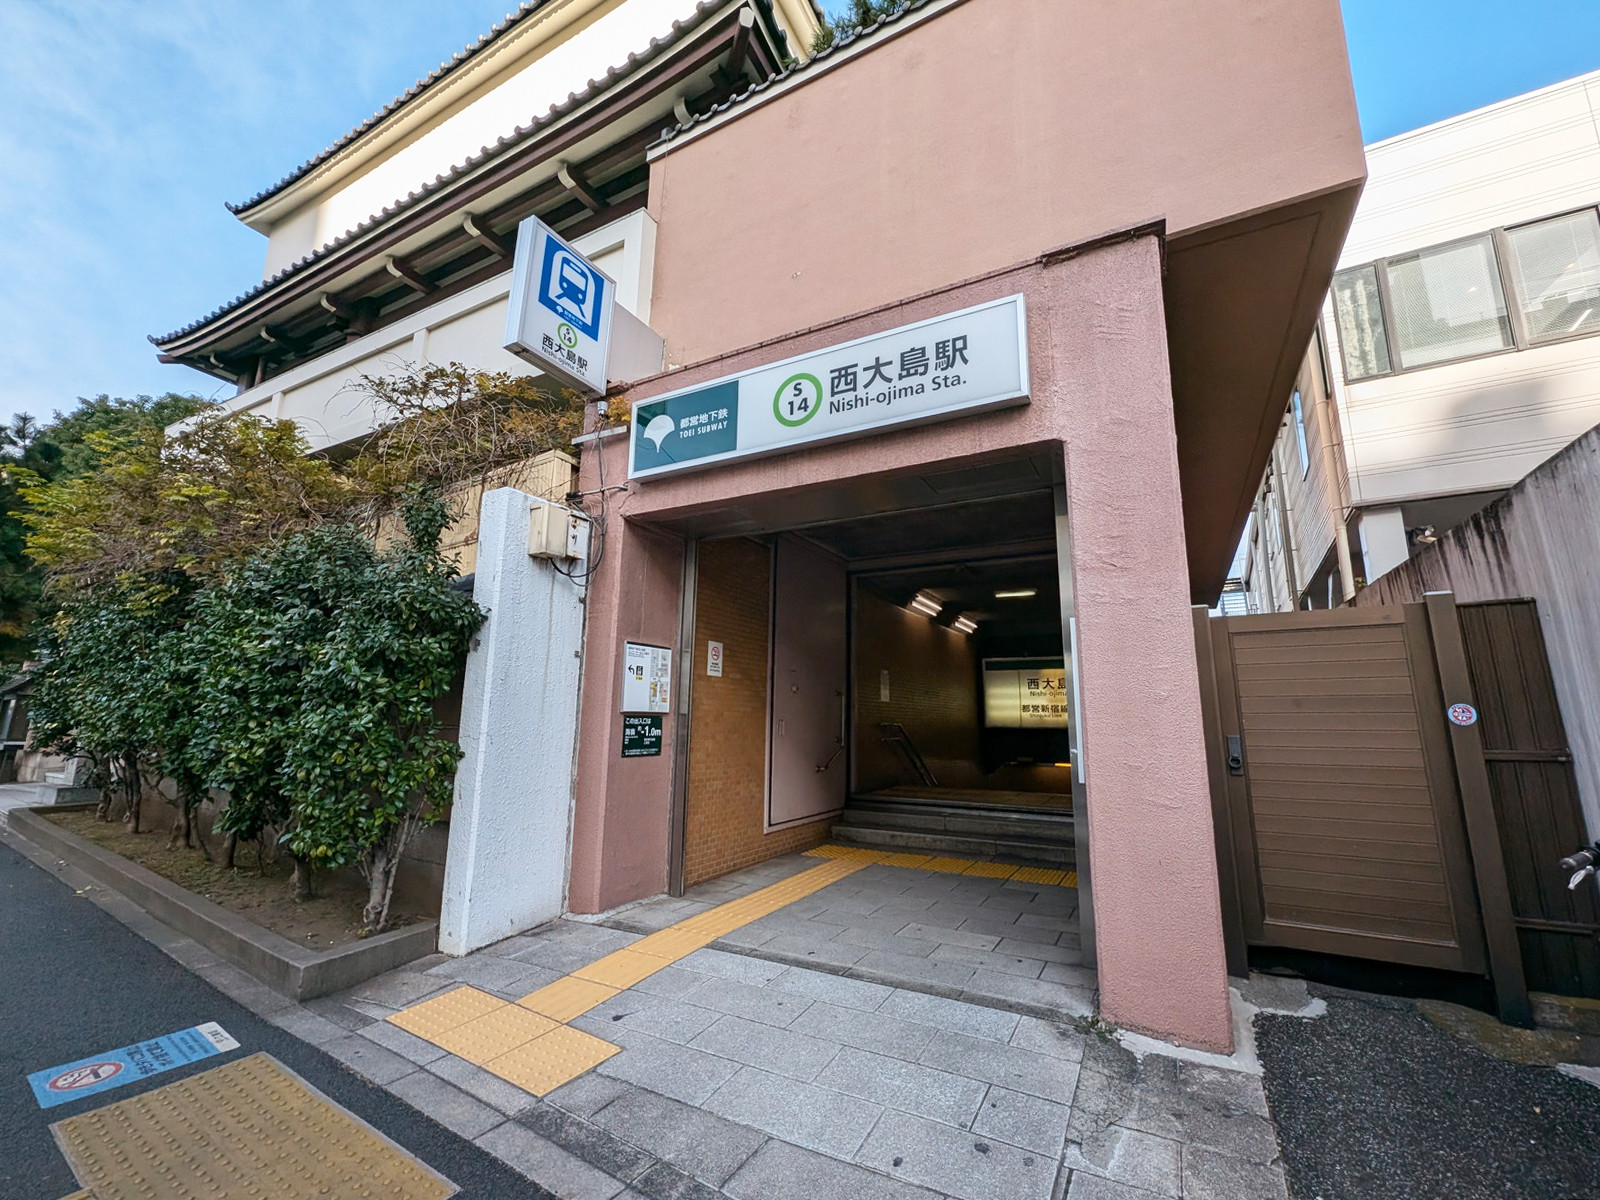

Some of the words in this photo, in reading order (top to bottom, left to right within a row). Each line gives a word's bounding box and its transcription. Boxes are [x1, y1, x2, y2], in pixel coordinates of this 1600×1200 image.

[563, 333, 572, 344] 14
[566, 327, 570, 335] S
[543, 333, 587, 372] 西大島駅
[829, 334, 969, 397] 西大島駅
[793, 382, 803, 397] S
[829, 383, 925, 415] Nishi-ojima
[931, 373, 967, 391] Sta.
[787, 398, 809, 416] 14
[680, 408, 728, 429] 都営地下鉄
[679, 428, 695, 439] TOEI
[697, 421, 728, 435] SUBWAY
